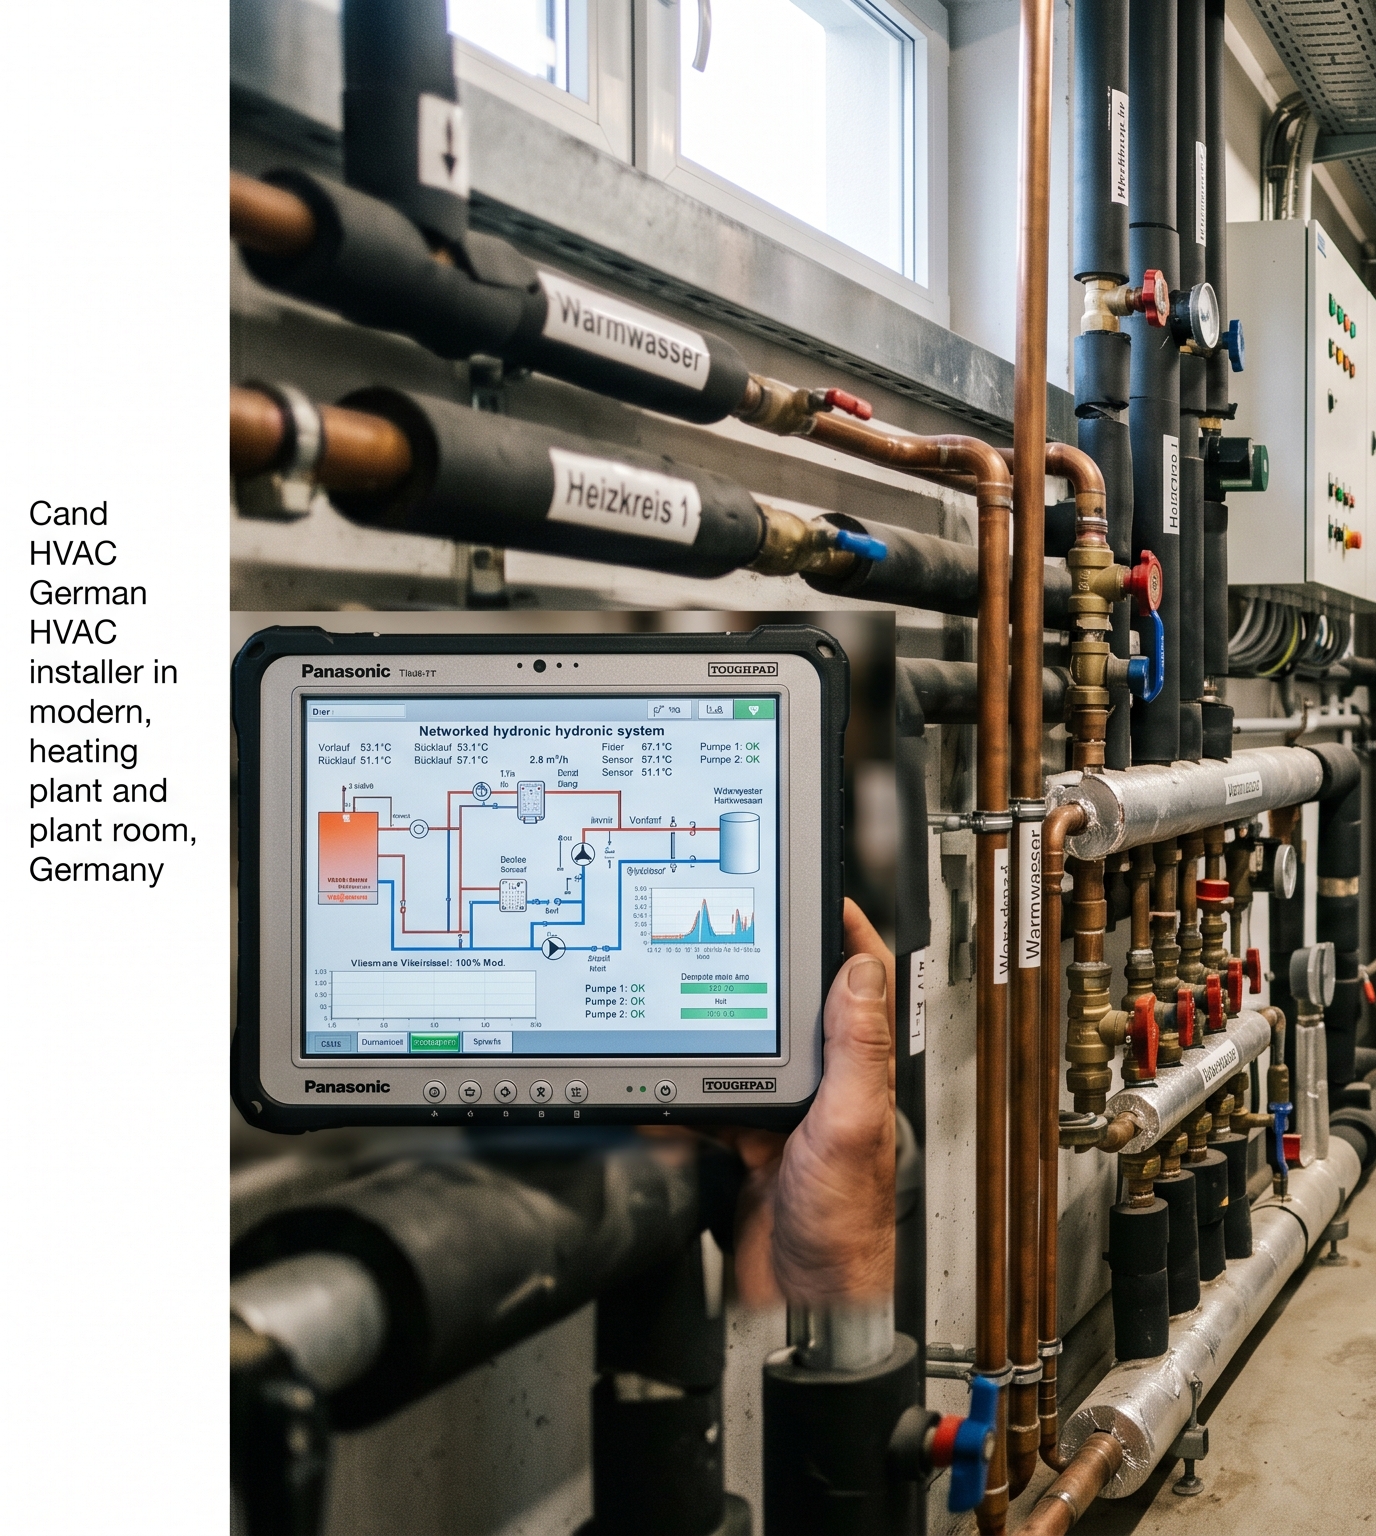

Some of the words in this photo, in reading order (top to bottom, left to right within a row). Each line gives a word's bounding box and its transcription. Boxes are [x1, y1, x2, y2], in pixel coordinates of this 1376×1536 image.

[557, 292, 702, 371] Warmwasser
[567, 469, 673, 524] Heizkreis
[681, 495, 689, 528] 1
[302, 664, 391, 678] Panasonic
[711, 666, 776, 674] TOUGHPAD
[420, 726, 488, 736] Networked
[494, 726, 550, 738] hydronic
[556, 726, 612, 738] hydronic
[617, 726, 664, 738] system
[318, 743, 350, 752] Vorlauf
[360, 743, 392, 752] 53.1°C
[457, 743, 488, 752] 53.1°C
[642, 743, 672, 751] 67.1°C
[700, 743, 732, 754] Pumpe
[734, 743, 742, 751] 1:
[746, 742, 760, 751] OK
[318, 756, 356, 765] Rücklauf
[360, 756, 392, 765] 51.1°C
[457, 756, 488, 765] 57.1°C
[530, 756, 544, 764] 2.8
[602, 756, 634, 764] Sensor
[642, 756, 672, 764] 57.1°C
[700, 756, 732, 766] Pumpe
[734, 756, 742, 764] 2:
[746, 756, 760, 764] OK
[602, 769, 634, 777] Sensor
[642, 769, 672, 777] 51.1°C
[456, 959, 481, 967] 100%
[484, 959, 506, 967] Mod.
[586, 984, 617, 995] Pumpe
[620, 984, 628, 993] 1:
[630, 984, 646, 993] OK
[586, 997, 617, 1008] Pumpe
[620, 997, 628, 1006] 2:
[630, 997, 646, 1006] OK
[586, 1010, 617, 1021] Pumpe
[620, 1010, 628, 1018] 2:
[630, 1010, 646, 1018] OK
[304, 1080, 390, 1094] Panasonic
[706, 1082, 774, 1090] TOUGHPAD
